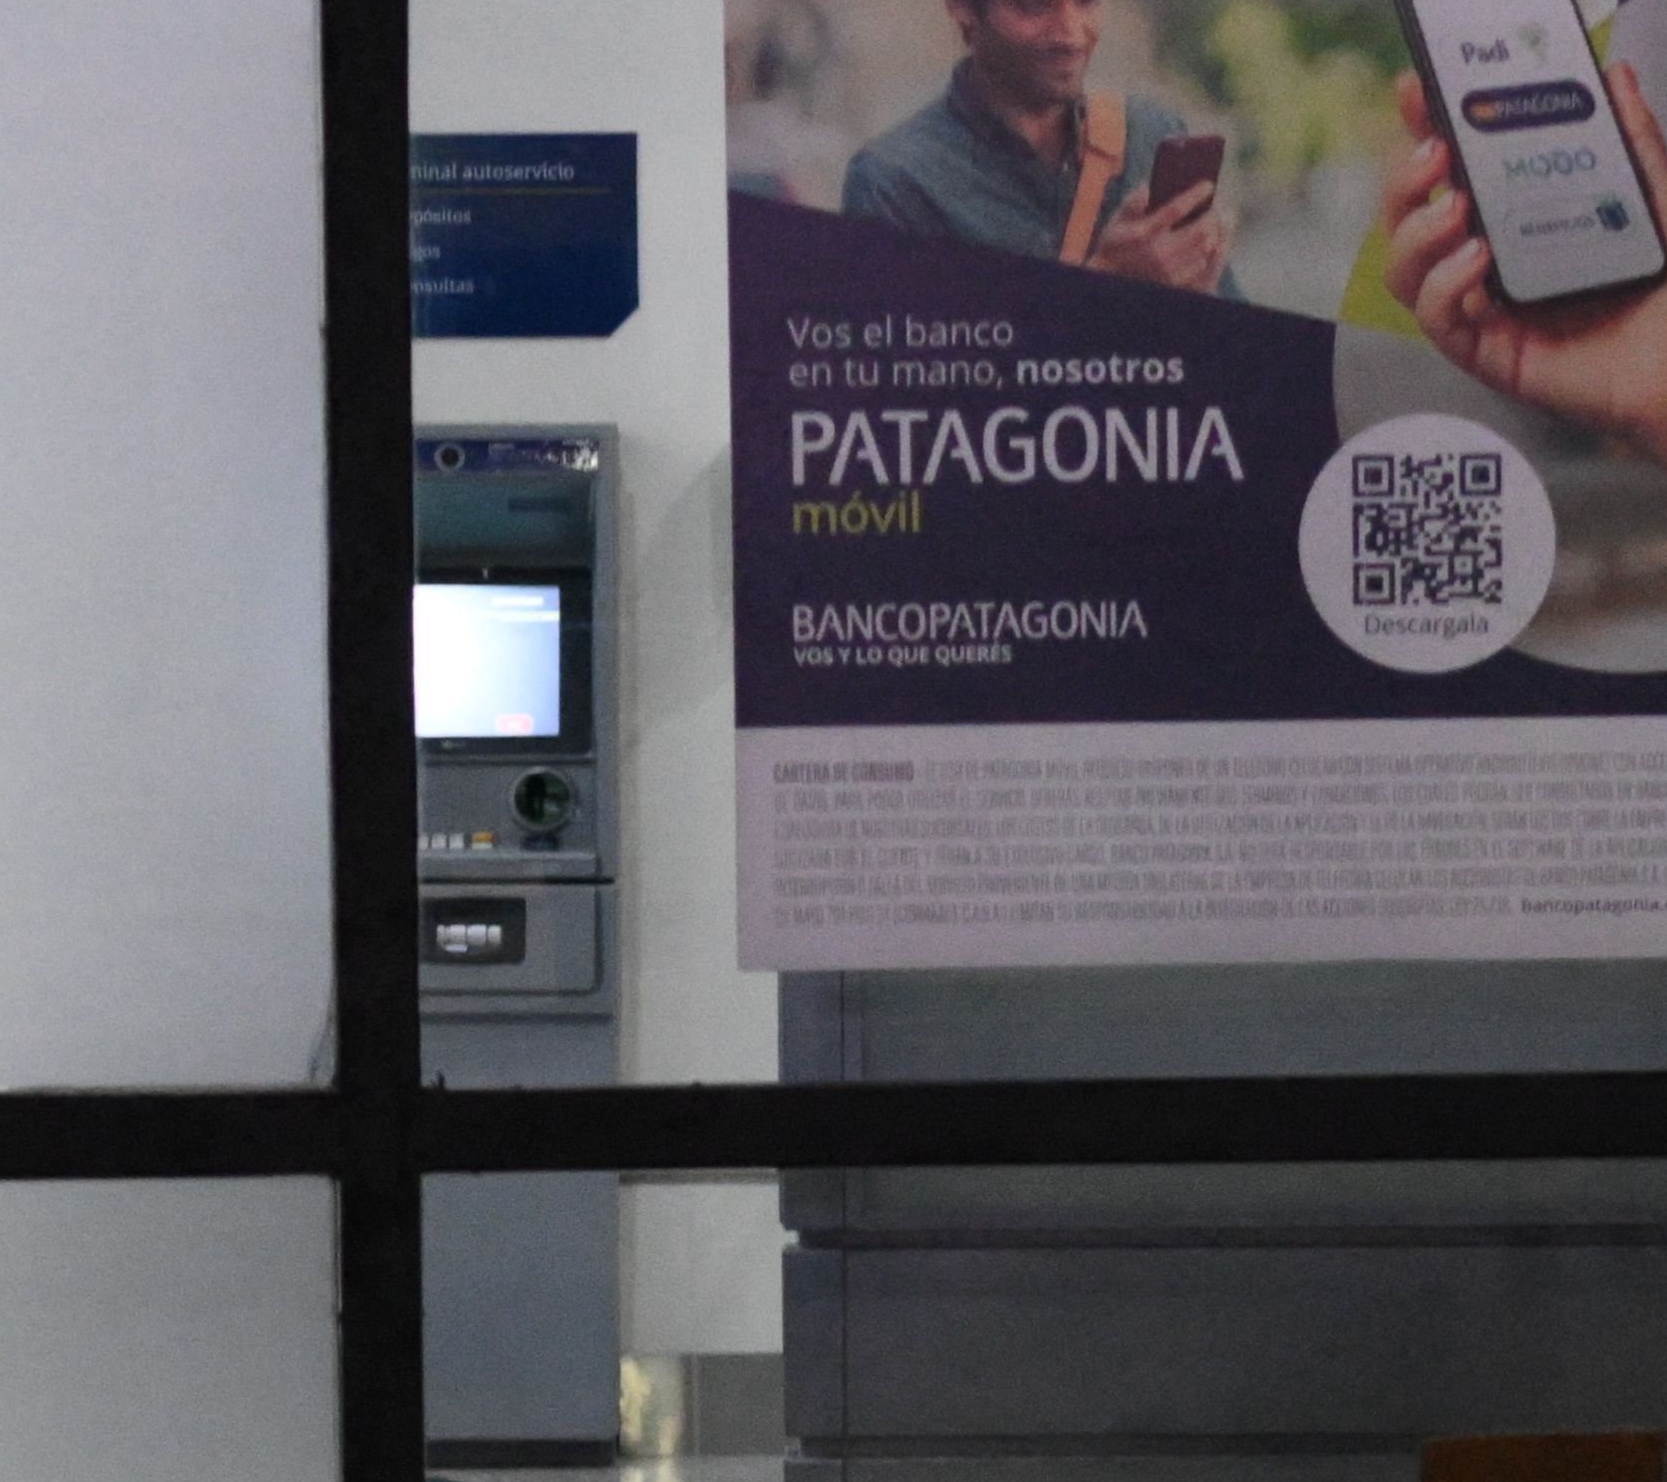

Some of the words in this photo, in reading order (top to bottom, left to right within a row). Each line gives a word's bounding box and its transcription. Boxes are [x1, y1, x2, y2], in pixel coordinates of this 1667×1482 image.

[462, 160, 575, 183] autoservicio
[413, 203, 472, 228] pósitos
[412, 278, 475, 295] nsultas
[786, 316, 852, 350] Vos
[863, 314, 892, 348] el
[905, 312, 1014, 348] banco
[788, 360, 832, 388] en
[845, 355, 880, 387] tu
[892, 357, 1005, 390] mano,
[1016, 351, 1185, 386] nosotros
[790, 405, 1245, 487] PATAGONIA
[792, 490, 922, 535] móvil
[792, 599, 1149, 641] BANCOPATAGONIA
[1364, 613, 1489, 638] Descargala
[792, 646, 832, 666] VOS
[839, 647, 852, 664] Y
[856, 645, 883, 664] LO
[888, 644, 930, 667] QUE
[934, 641, 1012, 665] QUERÉS
